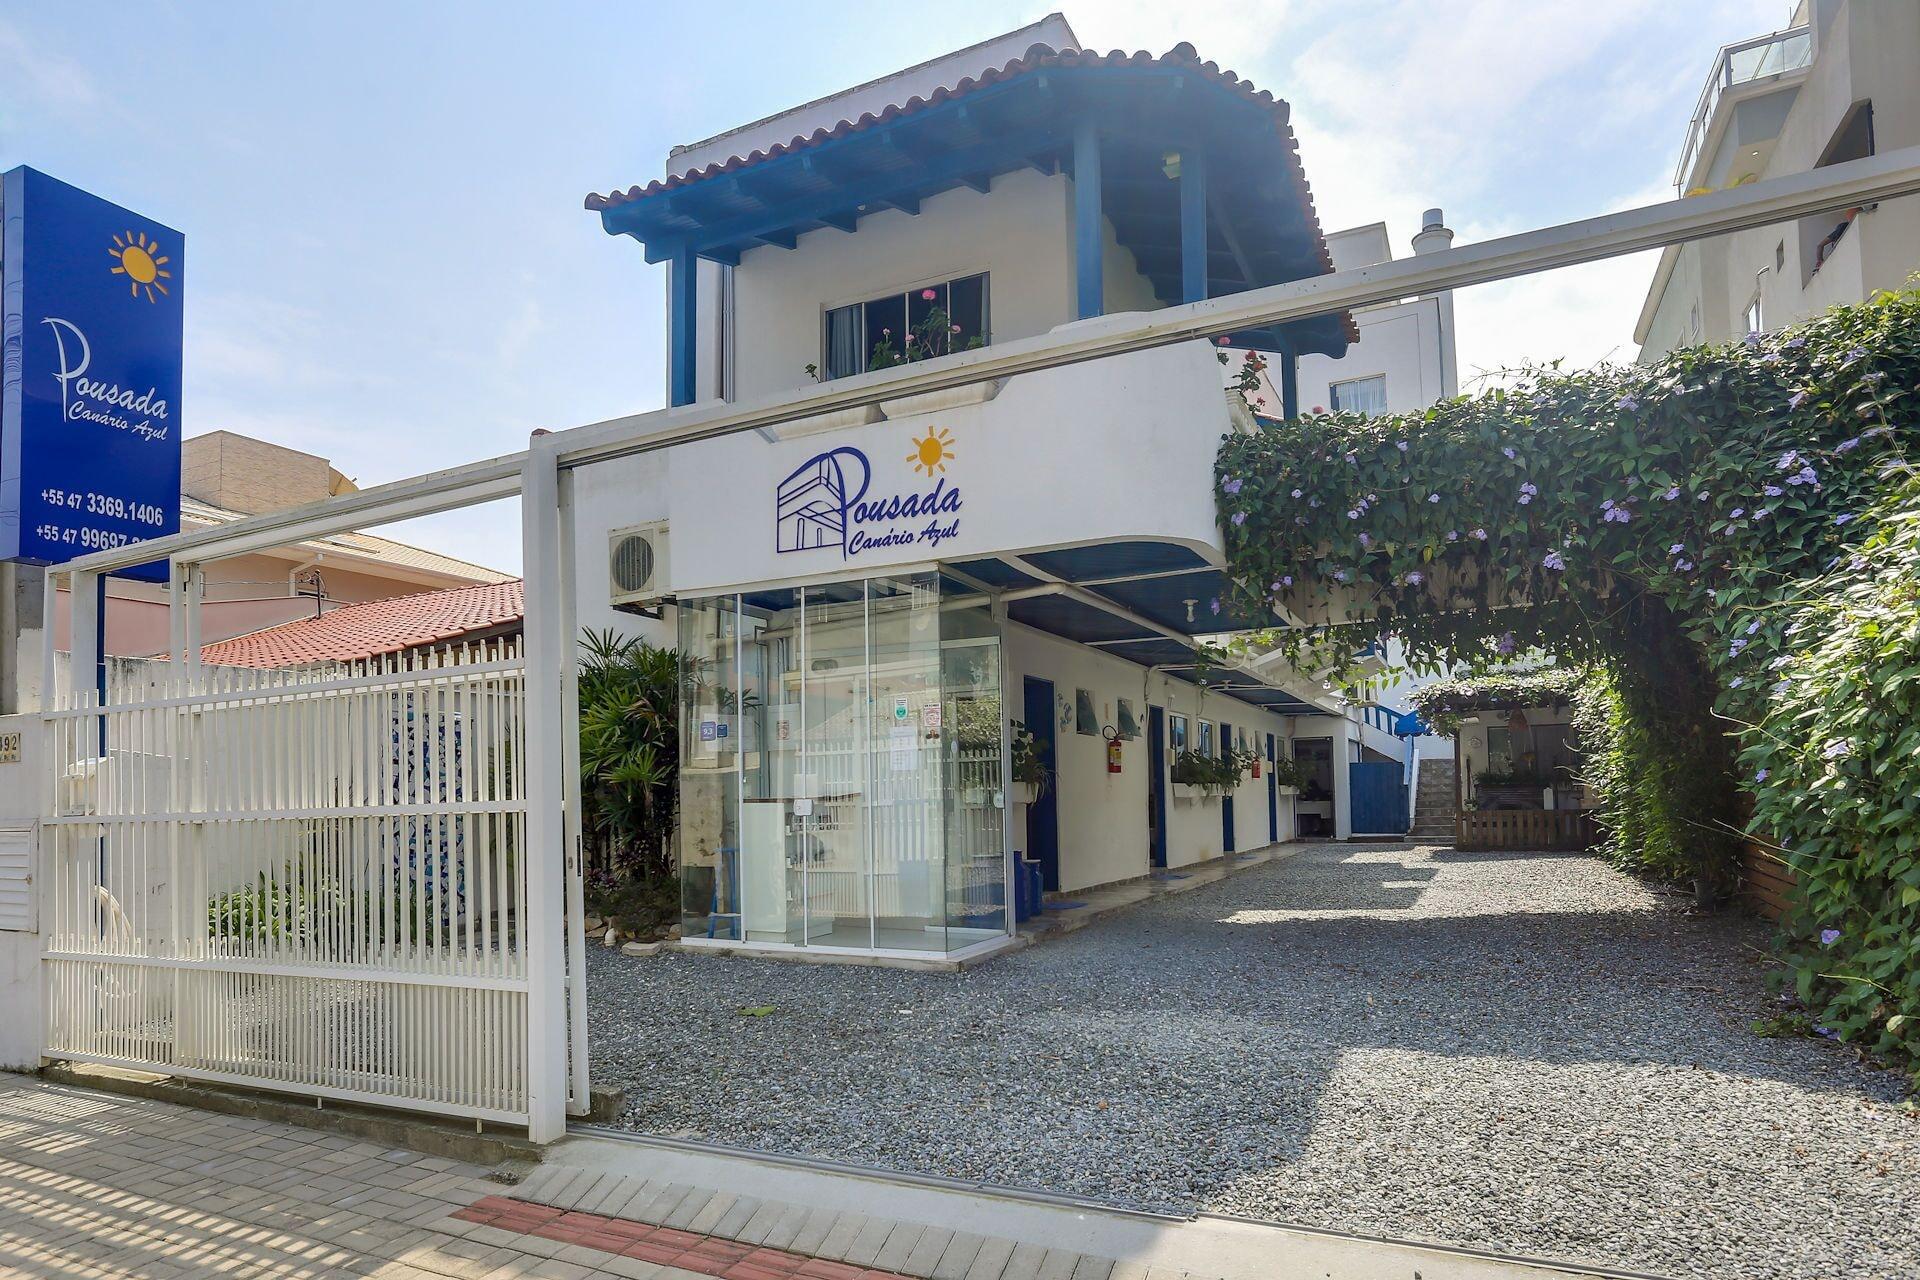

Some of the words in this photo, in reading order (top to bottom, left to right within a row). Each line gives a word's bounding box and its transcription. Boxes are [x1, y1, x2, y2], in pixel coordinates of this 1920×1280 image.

[40, 317, 168, 422] Pousada
[69, 401, 128, 430] Canário
[131, 420, 168, 441] Azul
[41, 489, 64, 506] +55
[67, 493, 82, 509] 47
[87, 492, 163, 526] 3369.1406
[827, 446, 963, 561] Pousada
[36, 524, 59, 541] +55
[62, 528, 77, 544] 47
[81, 527, 149, 550] 99697
[849, 528, 914, 555] Canário
[917, 518, 960, 547] Azul
